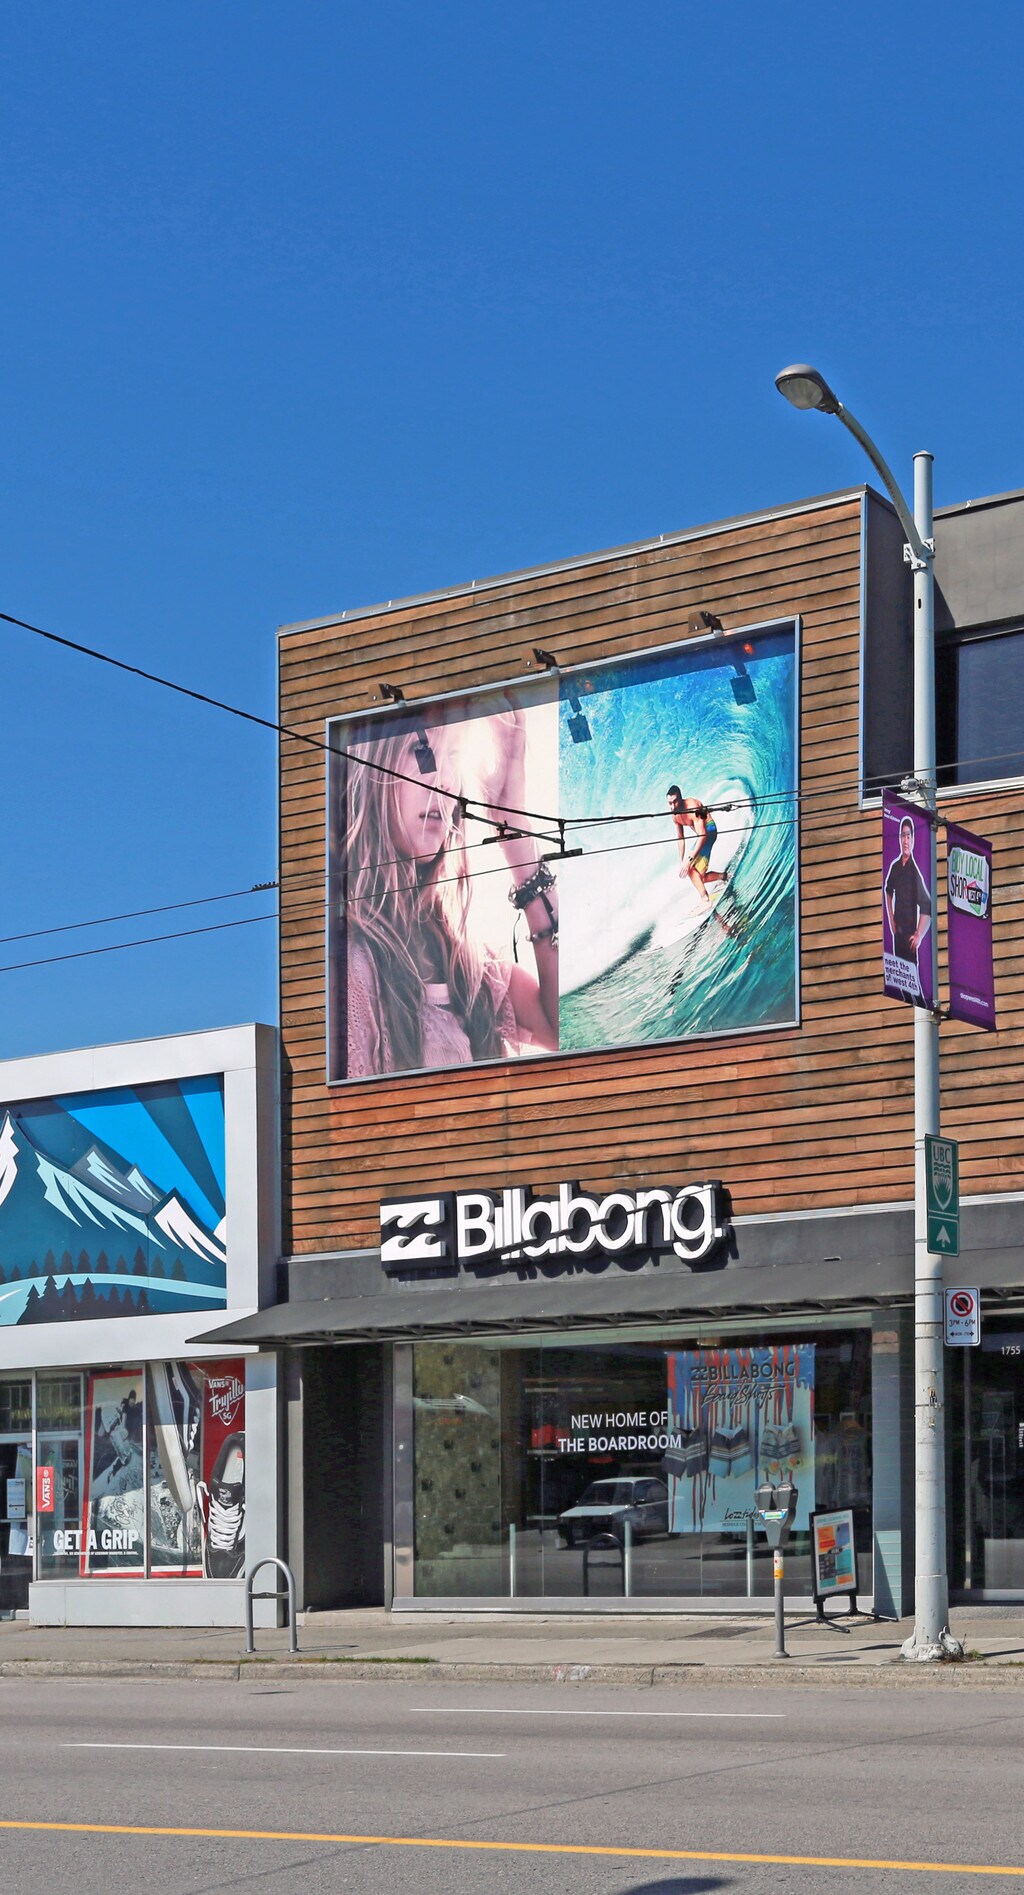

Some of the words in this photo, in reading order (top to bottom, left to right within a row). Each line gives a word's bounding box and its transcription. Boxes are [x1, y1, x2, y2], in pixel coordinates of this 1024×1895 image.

[952, 850, 965, 874] BUY
[966, 855, 983, 881] LOCAL
[933, 1145, 951, 1164] UBC
[948, 1319, 960, 1328] 3PM
[964, 1319, 976, 1327] 6PM
[1001, 1346, 1021, 1356] 1755
[707, 1361, 796, 1382] BILLABONG
[209, 1378, 244, 1413] Trujillo
[223, 1412, 232, 1420] SG
[571, 1414, 603, 1429] NEW
[605, 1412, 647, 1428] HOME
[650, 1411, 668, 1426] OF
[558, 1437, 586, 1453] THE
[588, 1434, 682, 1452] BOARDROOM
[53, 1529, 83, 1550] GET
[88, 1529, 98, 1550] A
[101, 1529, 139, 1550] GRIP
